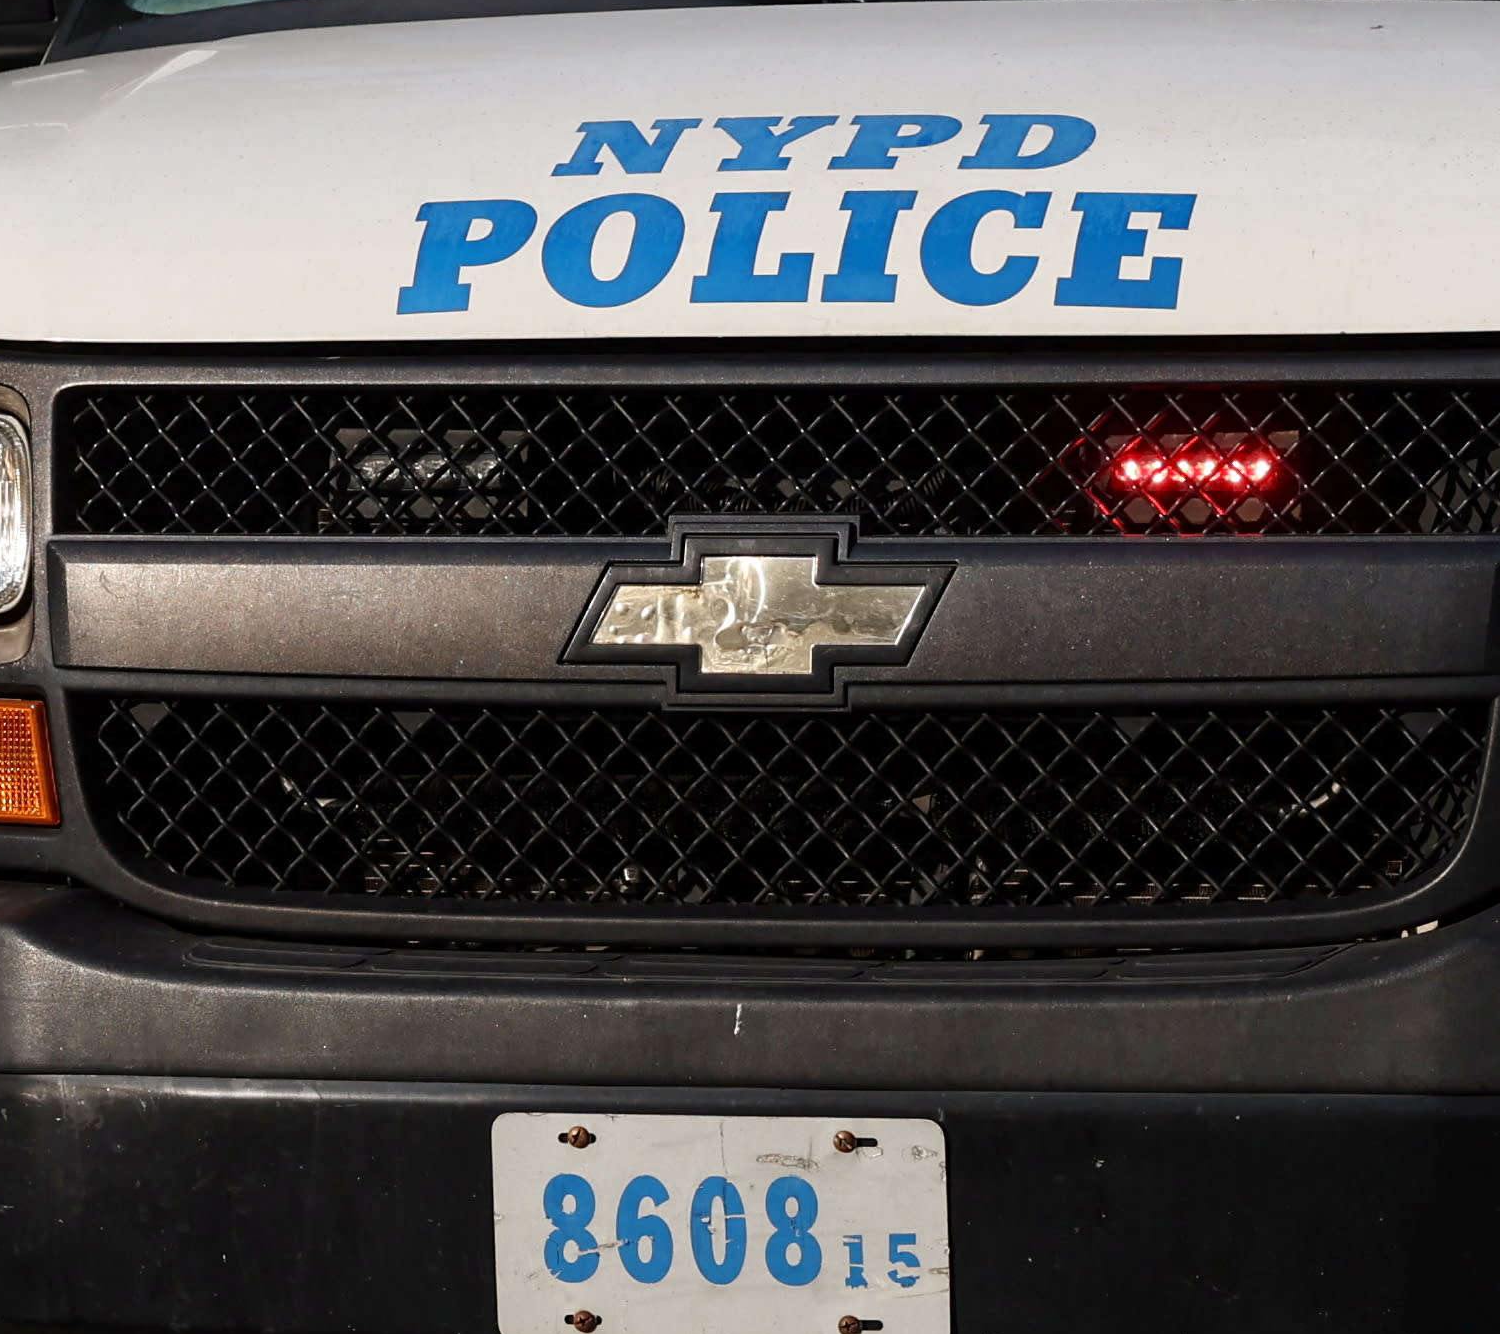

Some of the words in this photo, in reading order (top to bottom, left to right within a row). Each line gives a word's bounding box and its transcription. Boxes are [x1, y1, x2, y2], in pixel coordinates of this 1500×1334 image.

[551, 113, 1097, 177] NYPD
[396, 189, 1198, 316] POLICE
[543, 1173, 822, 1287] 8608
[842, 1233, 921, 1289] 15
